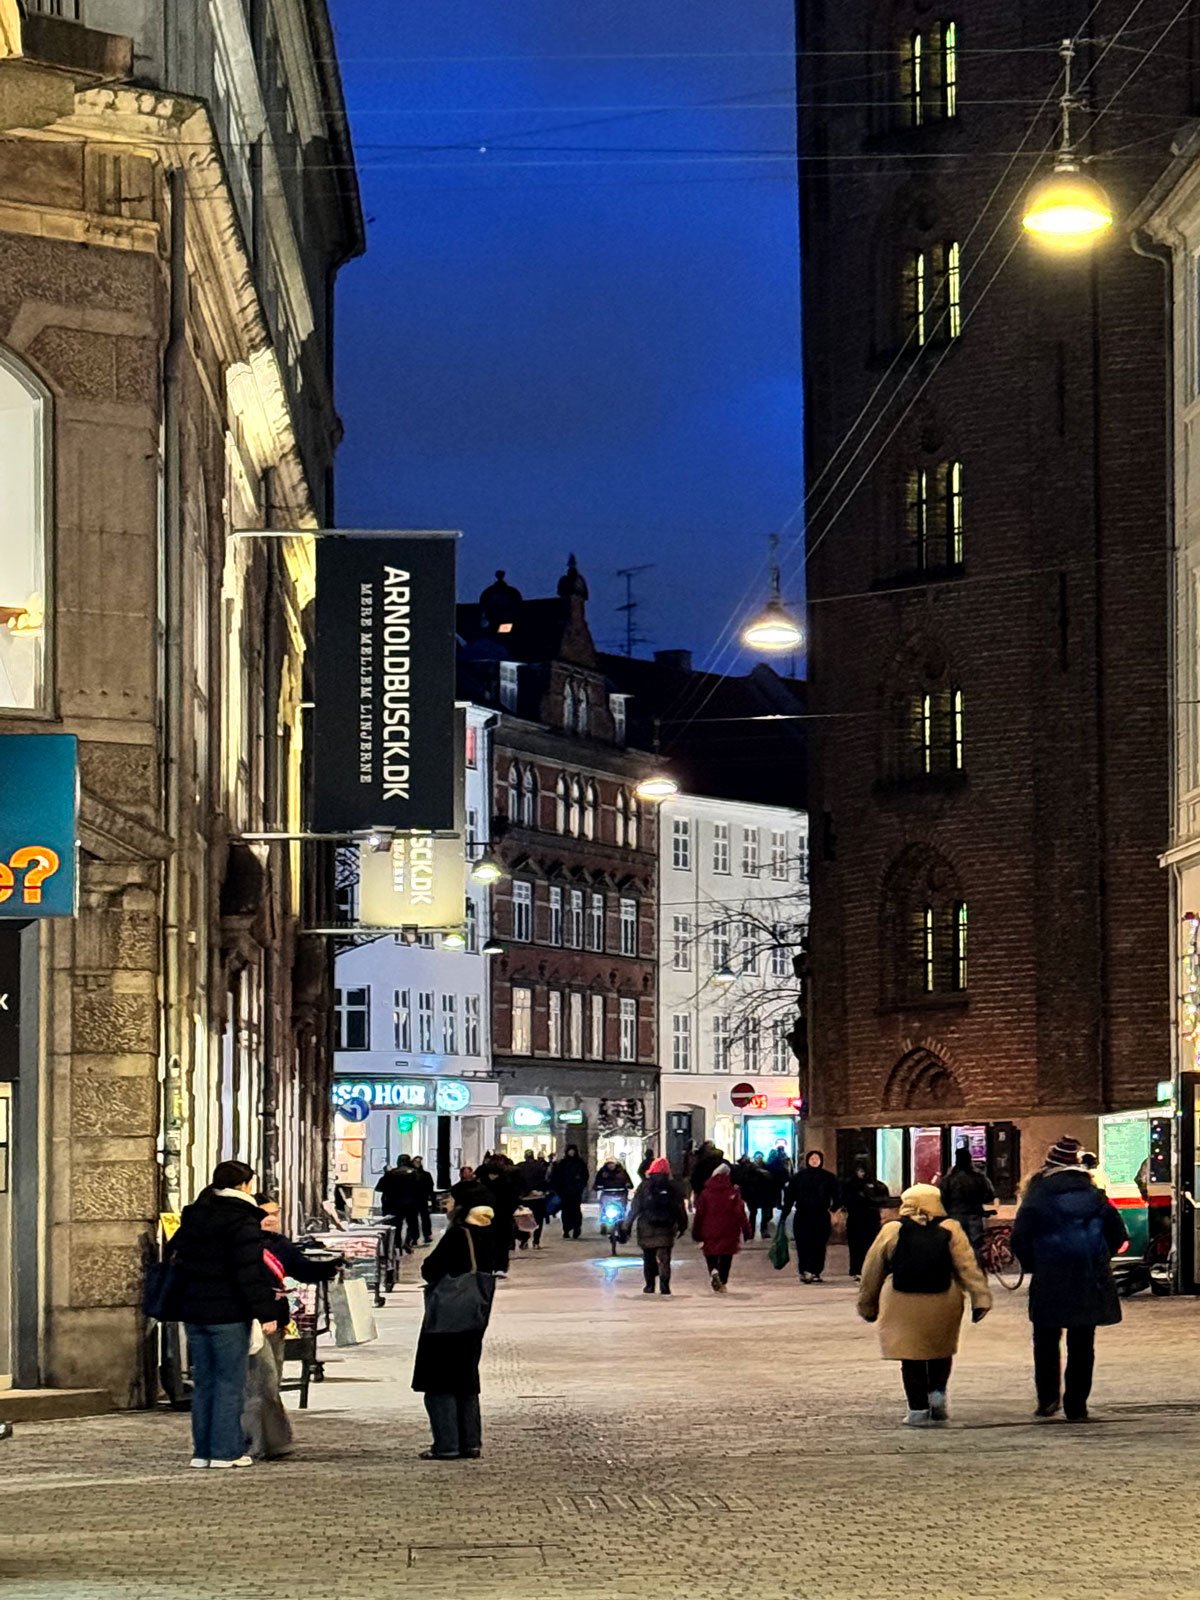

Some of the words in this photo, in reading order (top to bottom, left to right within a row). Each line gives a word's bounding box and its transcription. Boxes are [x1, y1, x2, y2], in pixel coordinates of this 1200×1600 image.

[360, 582, 373, 628] MERE
[359, 632, 373, 700] MELLEM
[383, 565, 411, 801] ARNOLDBUSCK.DK
[359, 703, 373, 784] LINJERNE
